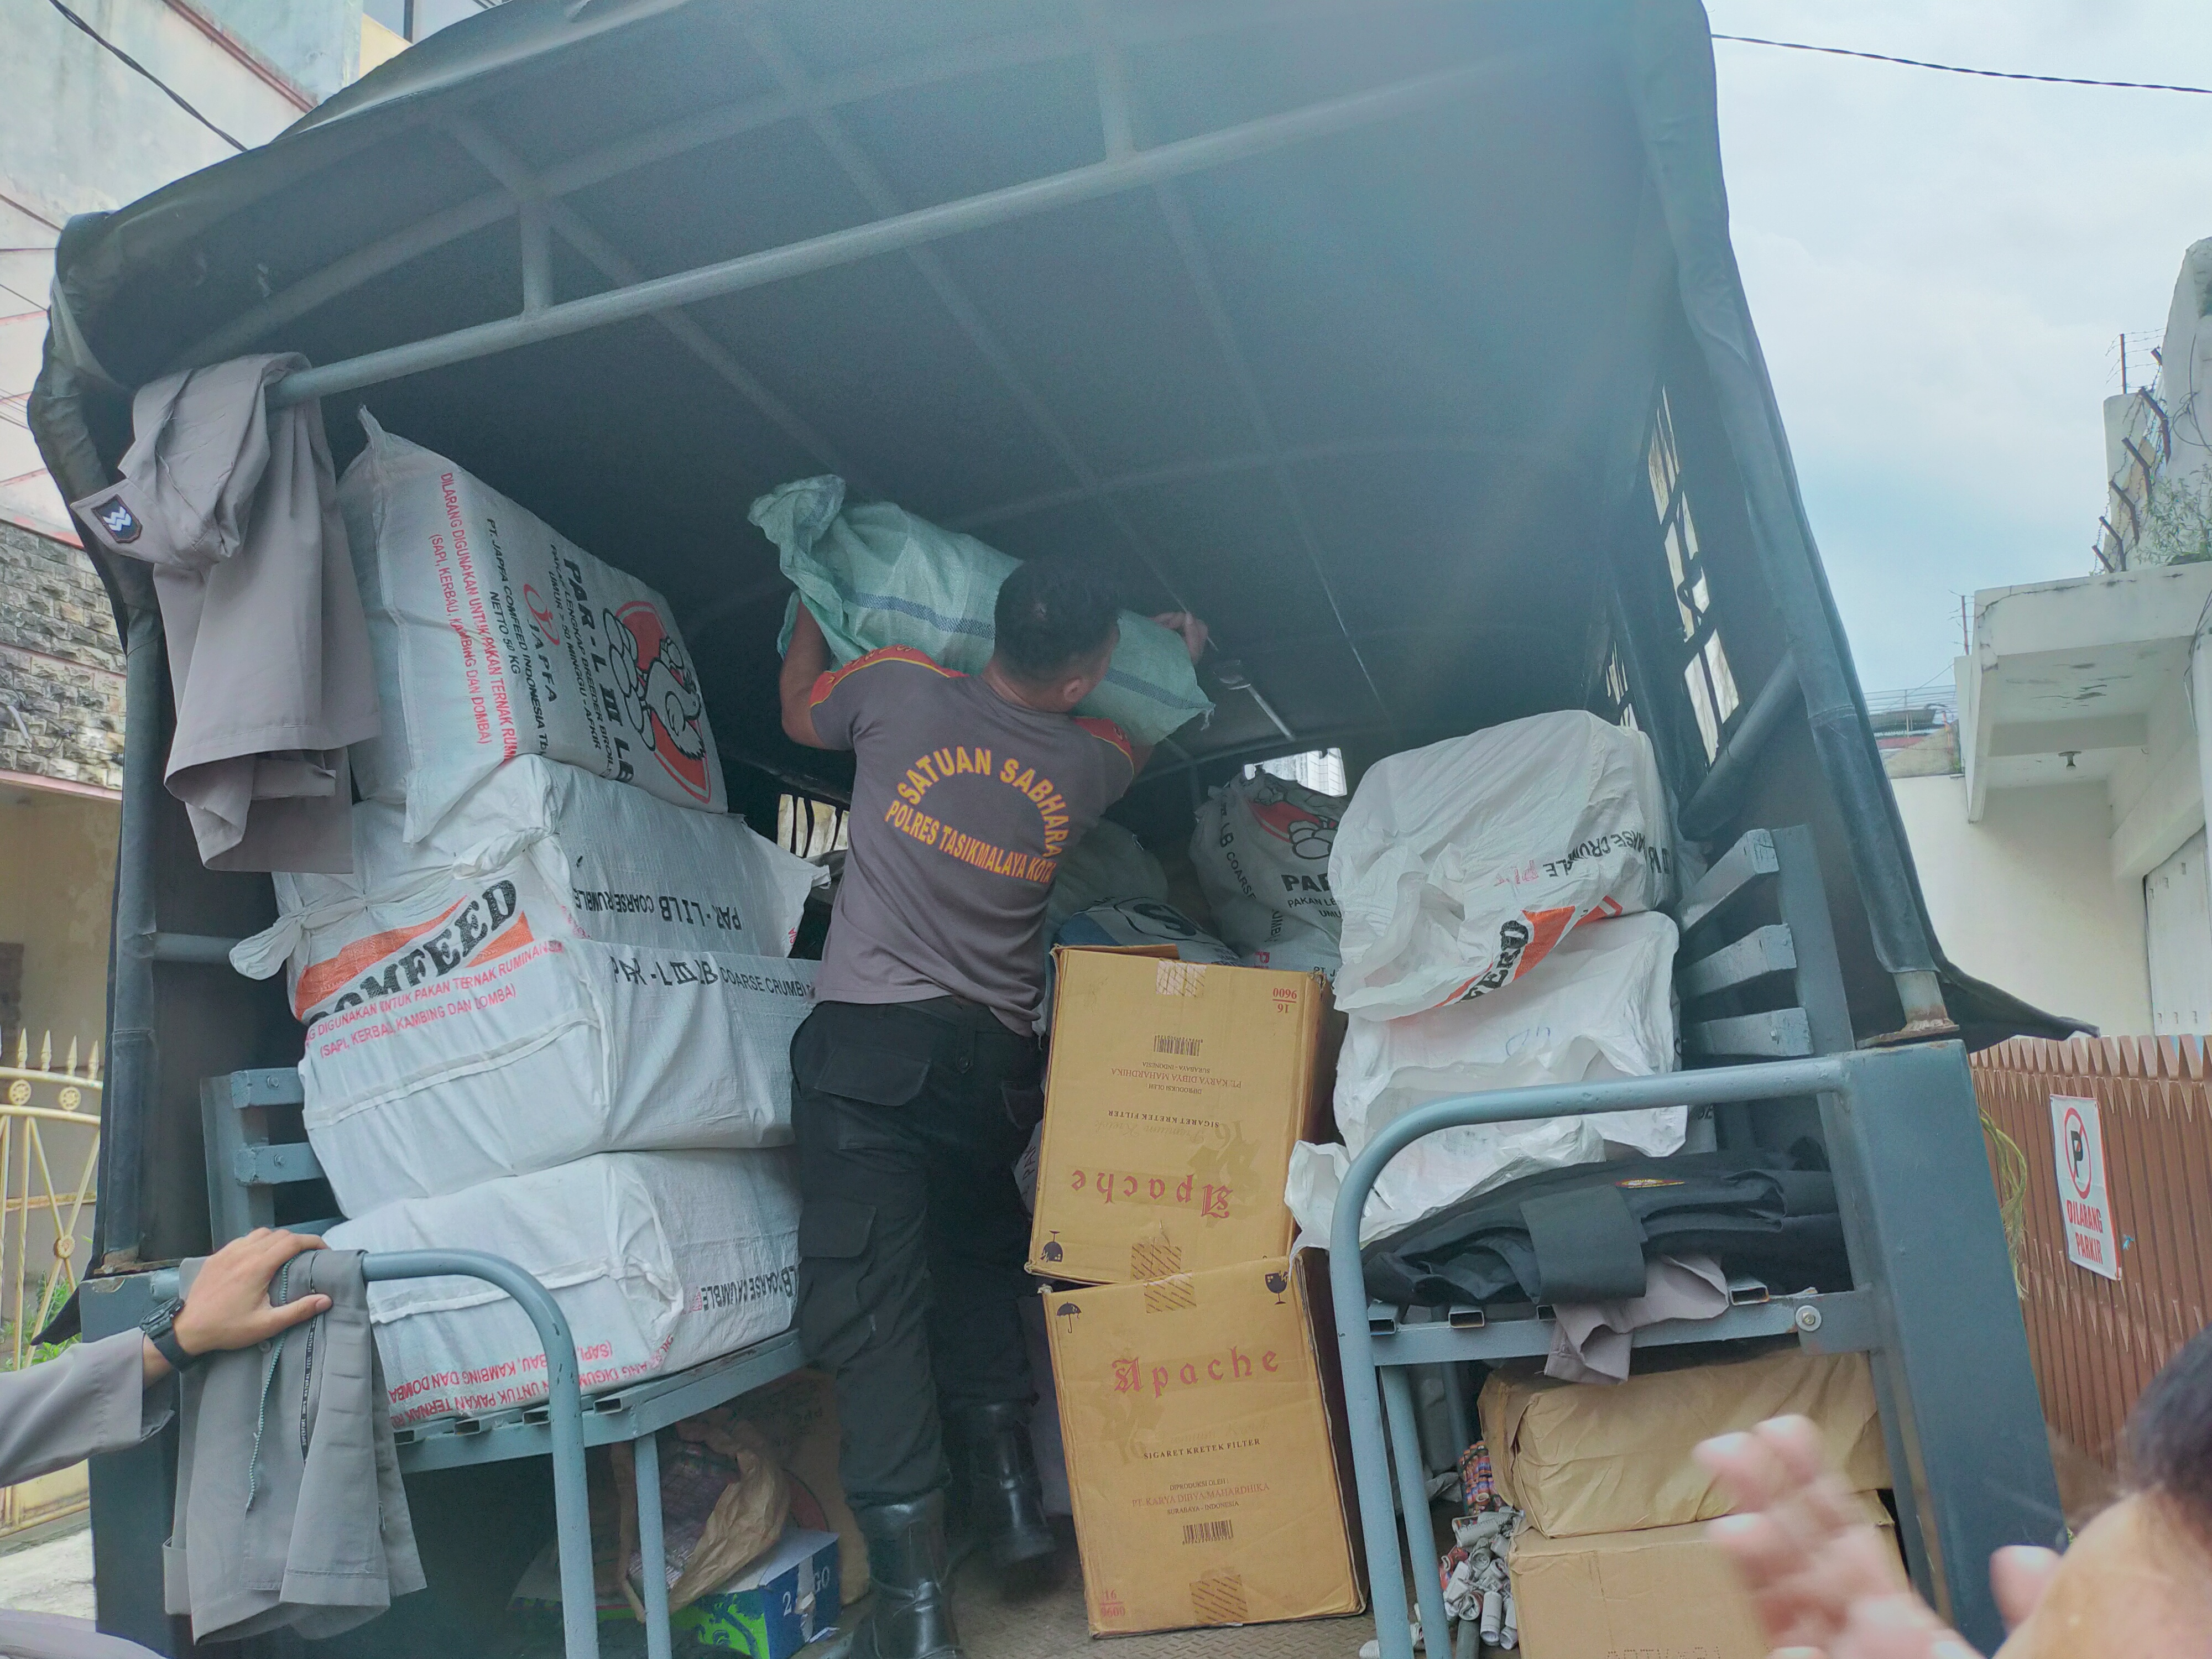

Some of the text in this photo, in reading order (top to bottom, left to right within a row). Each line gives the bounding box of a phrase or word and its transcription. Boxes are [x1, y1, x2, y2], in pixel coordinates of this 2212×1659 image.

[441, 473, 462, 527] DILARANG
[452, 530, 478, 595] DIGUNAKAN
[483, 638, 501, 675] PAKAN
[492, 680, 512, 726] TERNAK
[564, 559, 594, 625] PAR
[487, 519, 497, 536] PT.
[493, 541, 508, 581] JAPFA
[504, 586, 528, 650] COMFEED
[523, 655, 545, 728] INDONESIA
[490, 592, 509, 634] NETTO
[509, 655, 520, 674] KG
[429, 534, 492, 745] (SAPI, KERBAU, KAMBING DAN DOMBA)
[528, 619, 557, 701] JAPFA
[549, 572, 562, 609] UMUR
[568, 644, 587, 696] MINGGU
[585, 709, 601, 749] AFKIR
[565, 591, 585, 655] LENGKAP
[582, 658, 603, 721] BREEDER
[898, 746, 1069, 858] SATUAN SABHARA
[885, 800, 940, 845] POLRES
[938, 825, 1027, 878] TASIKMALAYA
[614, 894, 654, 913] COARSE
[1288, 898, 1322, 908] PAKAN
[719, 967, 765, 992] COARSE
[317, 1003, 378, 1036] DIGUNAKAN
[414, 982, 450, 1001] PAKAN
[452, 967, 497, 990] TERNAK
[1277, 1003, 1290, 1013] 16
[320, 1039, 349, 1058] (SAPI,
[396, 1005, 446, 1031] KAMBING
[447, 1000, 472, 1015] DAN
[1111, 1068, 1169, 1081] MAHARDHIKA
[1171, 1074, 1197, 1084] DIBYA
[1178, 1065, 1210, 1073] SURABAYA
[1166, 1085, 1202, 1094] DIPRODUKSI
[1199, 1077, 1228, 1087] KARYA
[1108, 1110, 1219, 1128] SIGARET KRETEK FILTER
[1071, 1170, 1234, 1218] Apache
[2067, 1199, 2103, 1234] DILARANG
[2075, 1232, 2103, 1264] PARKIR
[431, 1371, 458, 1387] DAN
[462, 1361, 516, 1384] KAMBING
[1112, 1345, 1280, 1398] Apache
[455, 1391, 495, 1413] PAKAN
[498, 1382, 539, 1404] UNTUK
[405, 1397, 452, 1423] TERNAK
[1144, 1438, 1260, 1460] SIGARET KRETEK FILTER
[1145, 1495, 1175, 1506] KARYA
[1177, 1493, 1205, 1504] DIBYA
[1207, 1484, 1270, 1499] MAHARDHIKA
[1170, 1480, 1208, 1491] DIPRODUKSI
[1167, 1506, 1199, 1515] SURABAYA
[1205, 1501, 1239, 1510] INDONESIA
